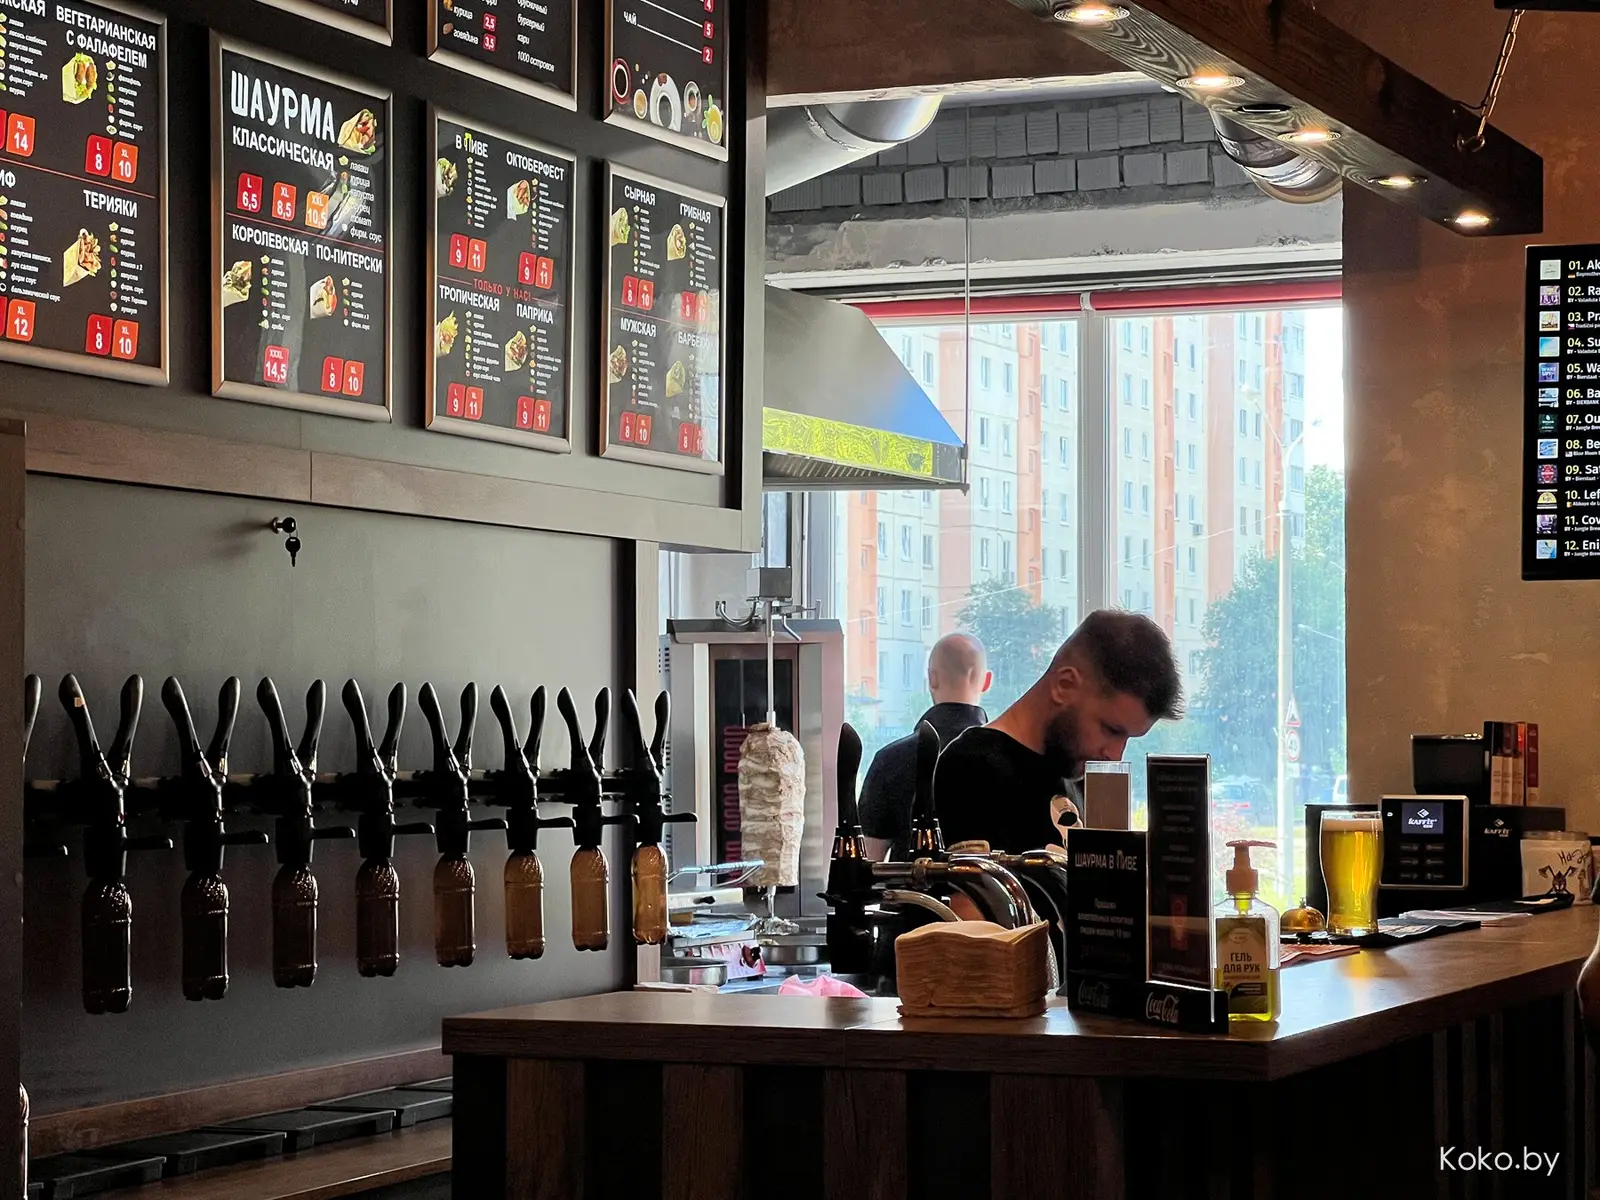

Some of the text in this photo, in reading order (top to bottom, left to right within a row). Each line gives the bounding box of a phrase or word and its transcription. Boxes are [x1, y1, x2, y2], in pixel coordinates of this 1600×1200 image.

[485, 16, 495, 29] 2,5
[624, 11, 637, 25] ЧАЙ
[56, 5, 156, 51] ВЕГЕТАРИАНСКАЯ
[706, 26, 711, 36] 5
[454, 30, 479, 45] говядина
[484, 36, 495, 50] 3,5
[66, 30, 147, 69] С ФАЛАФЕЛЕМ
[706, 50, 711, 61] 2
[518, 50, 555, 72] 1000 островов
[231, 70, 336, 144] ШАУРМА
[17, 121, 25, 130] XL
[14, 132, 29, 151] 14
[96, 142, 101, 150] L
[456, 132, 489, 158] В ПИВЕ
[121, 149, 129, 158] XL
[232, 126, 335, 172] КЛАССИЧЕСКАЯ
[96, 154, 103, 171] 8
[118, 160, 132, 178] 10
[506, 151, 565, 181] ОКТОБЕРФЕСТ
[247, 178, 252, 188] L
[280, 187, 289, 198] XL
[624, 185, 656, 206] СЫРНАЯ
[83, 190, 138, 218] ТЕРИЯКИ
[242, 191, 258, 210] 6,5
[312, 196, 324, 207] XXL
[276, 200, 292, 220] 8,5
[680, 202, 711, 224] ГРИБНАЯ
[306, 208, 327, 227] 10,5
[232, 224, 309, 256] КОРОЛЕВСКАЯ
[368, 232, 382, 244] соус
[316, 244, 383, 274] ПО-ПИТЕРСКИ
[456, 249, 462, 263] 9
[472, 253, 481, 268] 11
[1568, 260, 1584, 270] 01.
[524, 268, 530, 281] 9
[540, 271, 548, 285] 11
[472, 278, 531, 301] ТОЛЬКО У НАС!
[628, 290, 633, 302] 8
[1568, 286, 1584, 296] 02.
[439, 284, 500, 312] ТРОПИЧЕСКАЯ
[642, 294, 650, 306] 10
[18, 306, 26, 315] XL
[516, 304, 554, 324] ПАПРИКА
[686, 304, 691, 317] 8
[1568, 312, 1600, 322] 03. Pr
[14, 318, 29, 336] 12
[96, 322, 101, 330] L
[122, 326, 129, 335] XL
[621, 317, 657, 337] МУЖСКАЯ
[96, 333, 103, 350] 8
[118, 337, 132, 355] 10
[1568, 338, 1584, 347] 04.
[265, 361, 287, 382] 14,5
[330, 362, 335, 371] L
[1566, 363, 1584, 373] 05.
[330, 372, 336, 388] 8
[348, 376, 359, 392] 10
[454, 388, 458, 396] L
[1566, 388, 1583, 399] 06.
[453, 398, 459, 412] 9
[470, 401, 478, 415] 11
[522, 411, 528, 424] 9
[538, 414, 546, 428] 11
[1566, 414, 1582, 424] 07.
[626, 426, 630, 438] 8
[640, 428, 648, 441] 10
[684, 436, 688, 449] 8
[1566, 440, 1582, 449] 08.
[1566, 465, 1582, 475] 09.
[1564, 490, 1581, 500] 10.
[1564, 516, 1579, 525] 11.
[1564, 540, 1579, 550] 12.
[1075, 853, 1107, 868] ШАУРМА
[1109, 854, 1114, 869] В
[1230, 952, 1252, 962] ГЕЛЬ
[1224, 964, 1260, 973] ДЛЯ РУК
